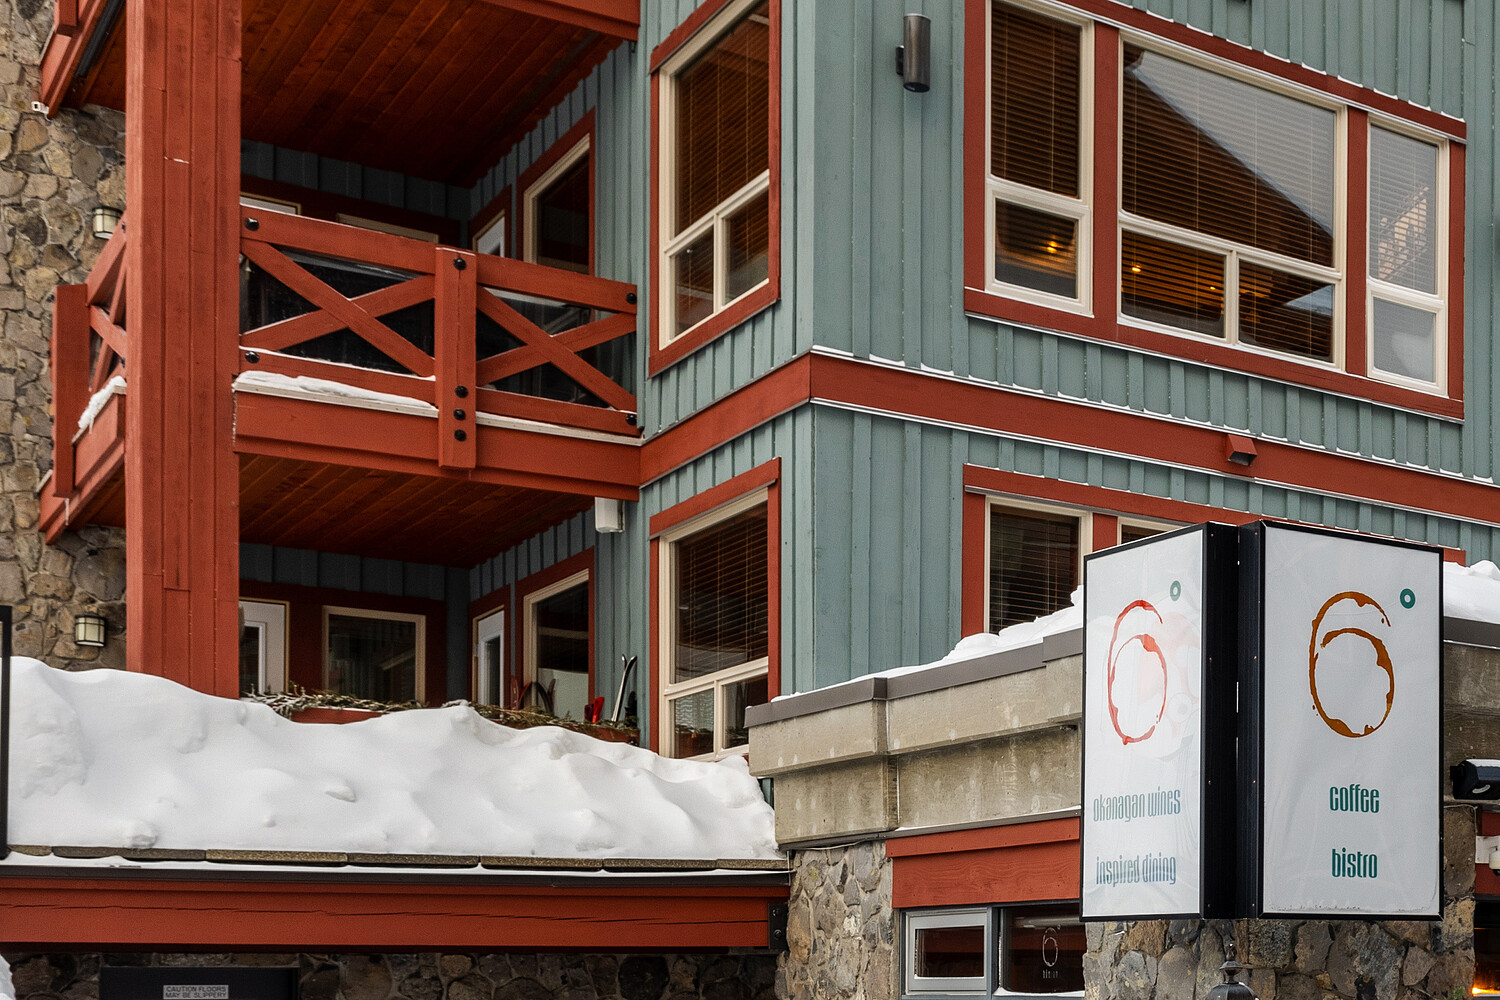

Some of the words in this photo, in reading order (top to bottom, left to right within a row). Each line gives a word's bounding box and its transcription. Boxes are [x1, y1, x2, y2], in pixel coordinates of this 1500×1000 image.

[1093, 791, 1146, 823] okanagan
[1146, 786, 1181, 818] wines
[1329, 783, 1380, 814] coffee
[1096, 854, 1141, 887] inspired
[1142, 851, 1177, 886] dining
[1331, 847, 1378, 880] bistro
